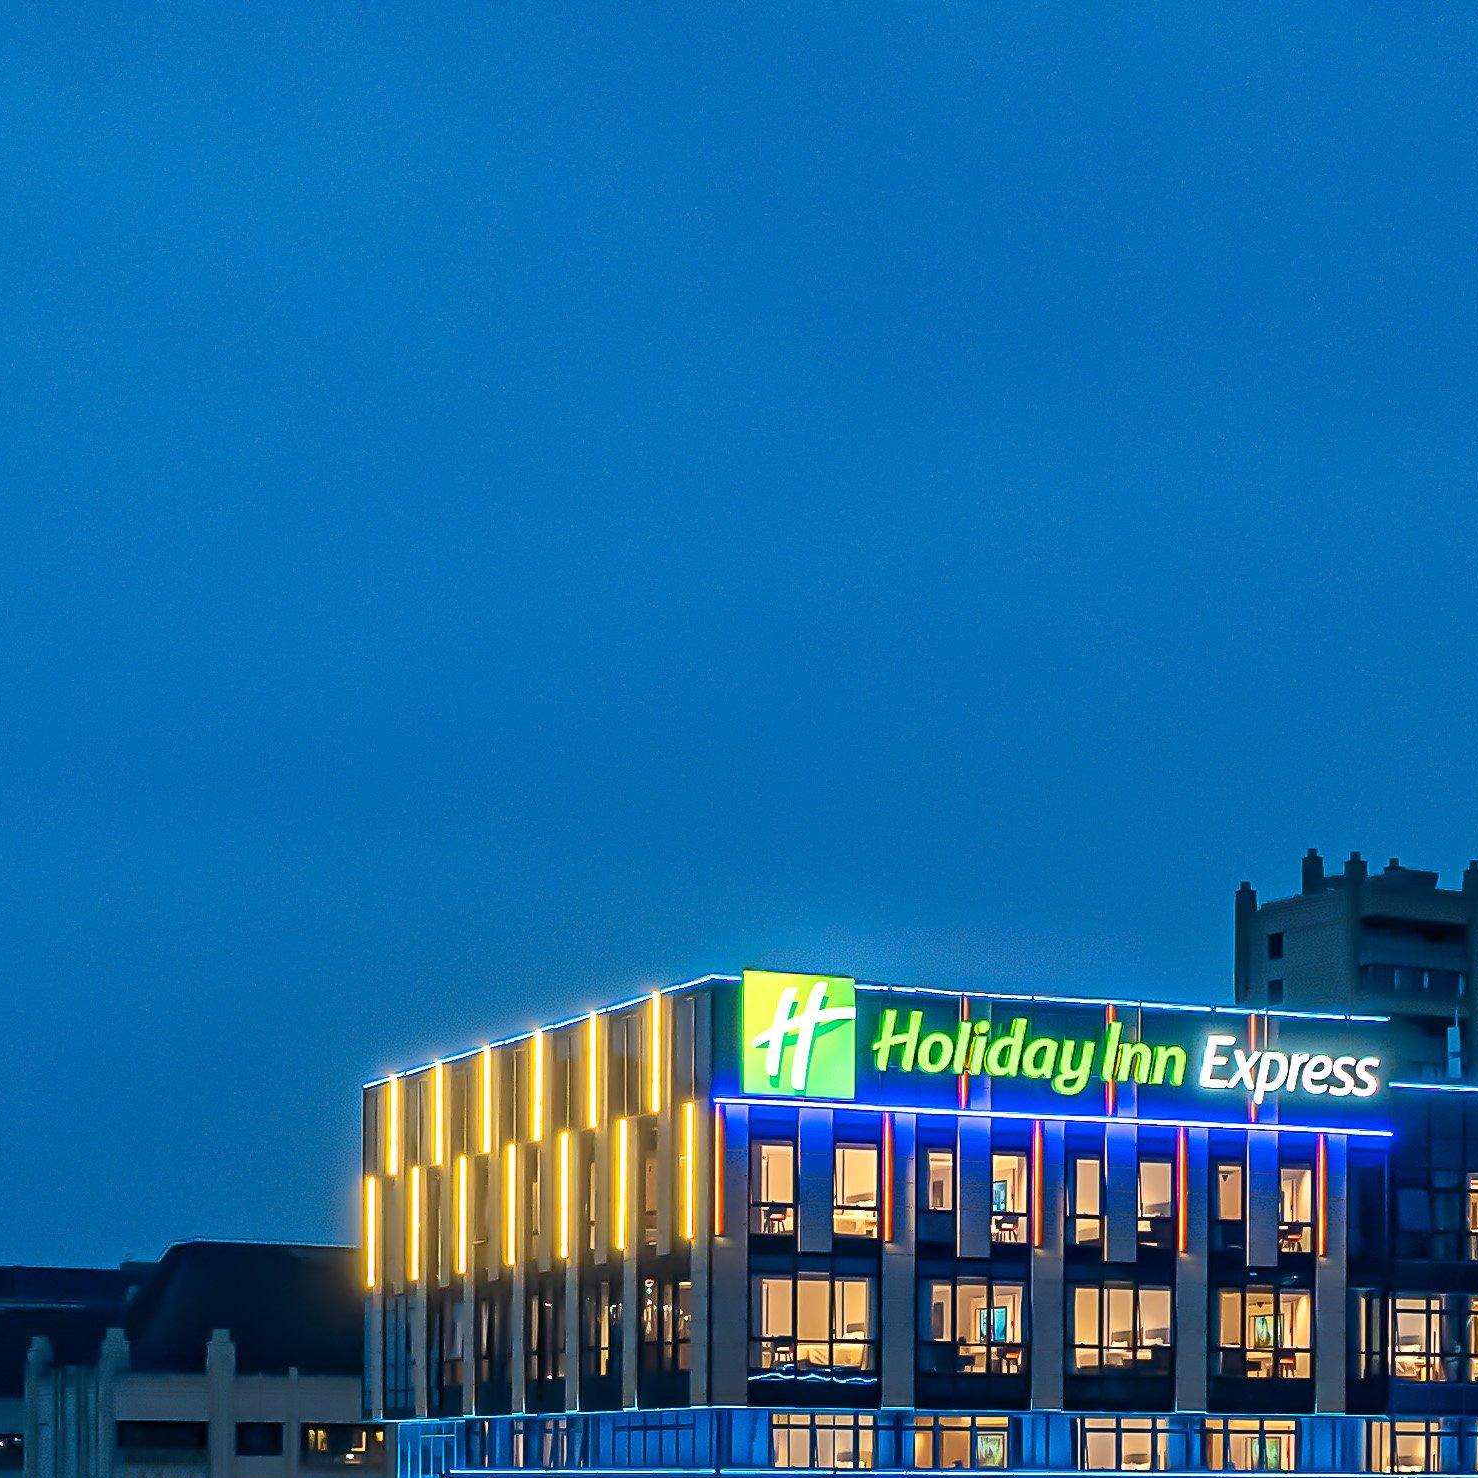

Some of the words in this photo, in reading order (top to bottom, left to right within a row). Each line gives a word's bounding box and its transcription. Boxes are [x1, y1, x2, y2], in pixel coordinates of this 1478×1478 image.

[753, 981, 856, 1091] H
[871, 1008, 1097, 1095] Holiday
[1101, 1020, 1188, 1086] Inn
[1199, 1034, 1380, 1104] Express
